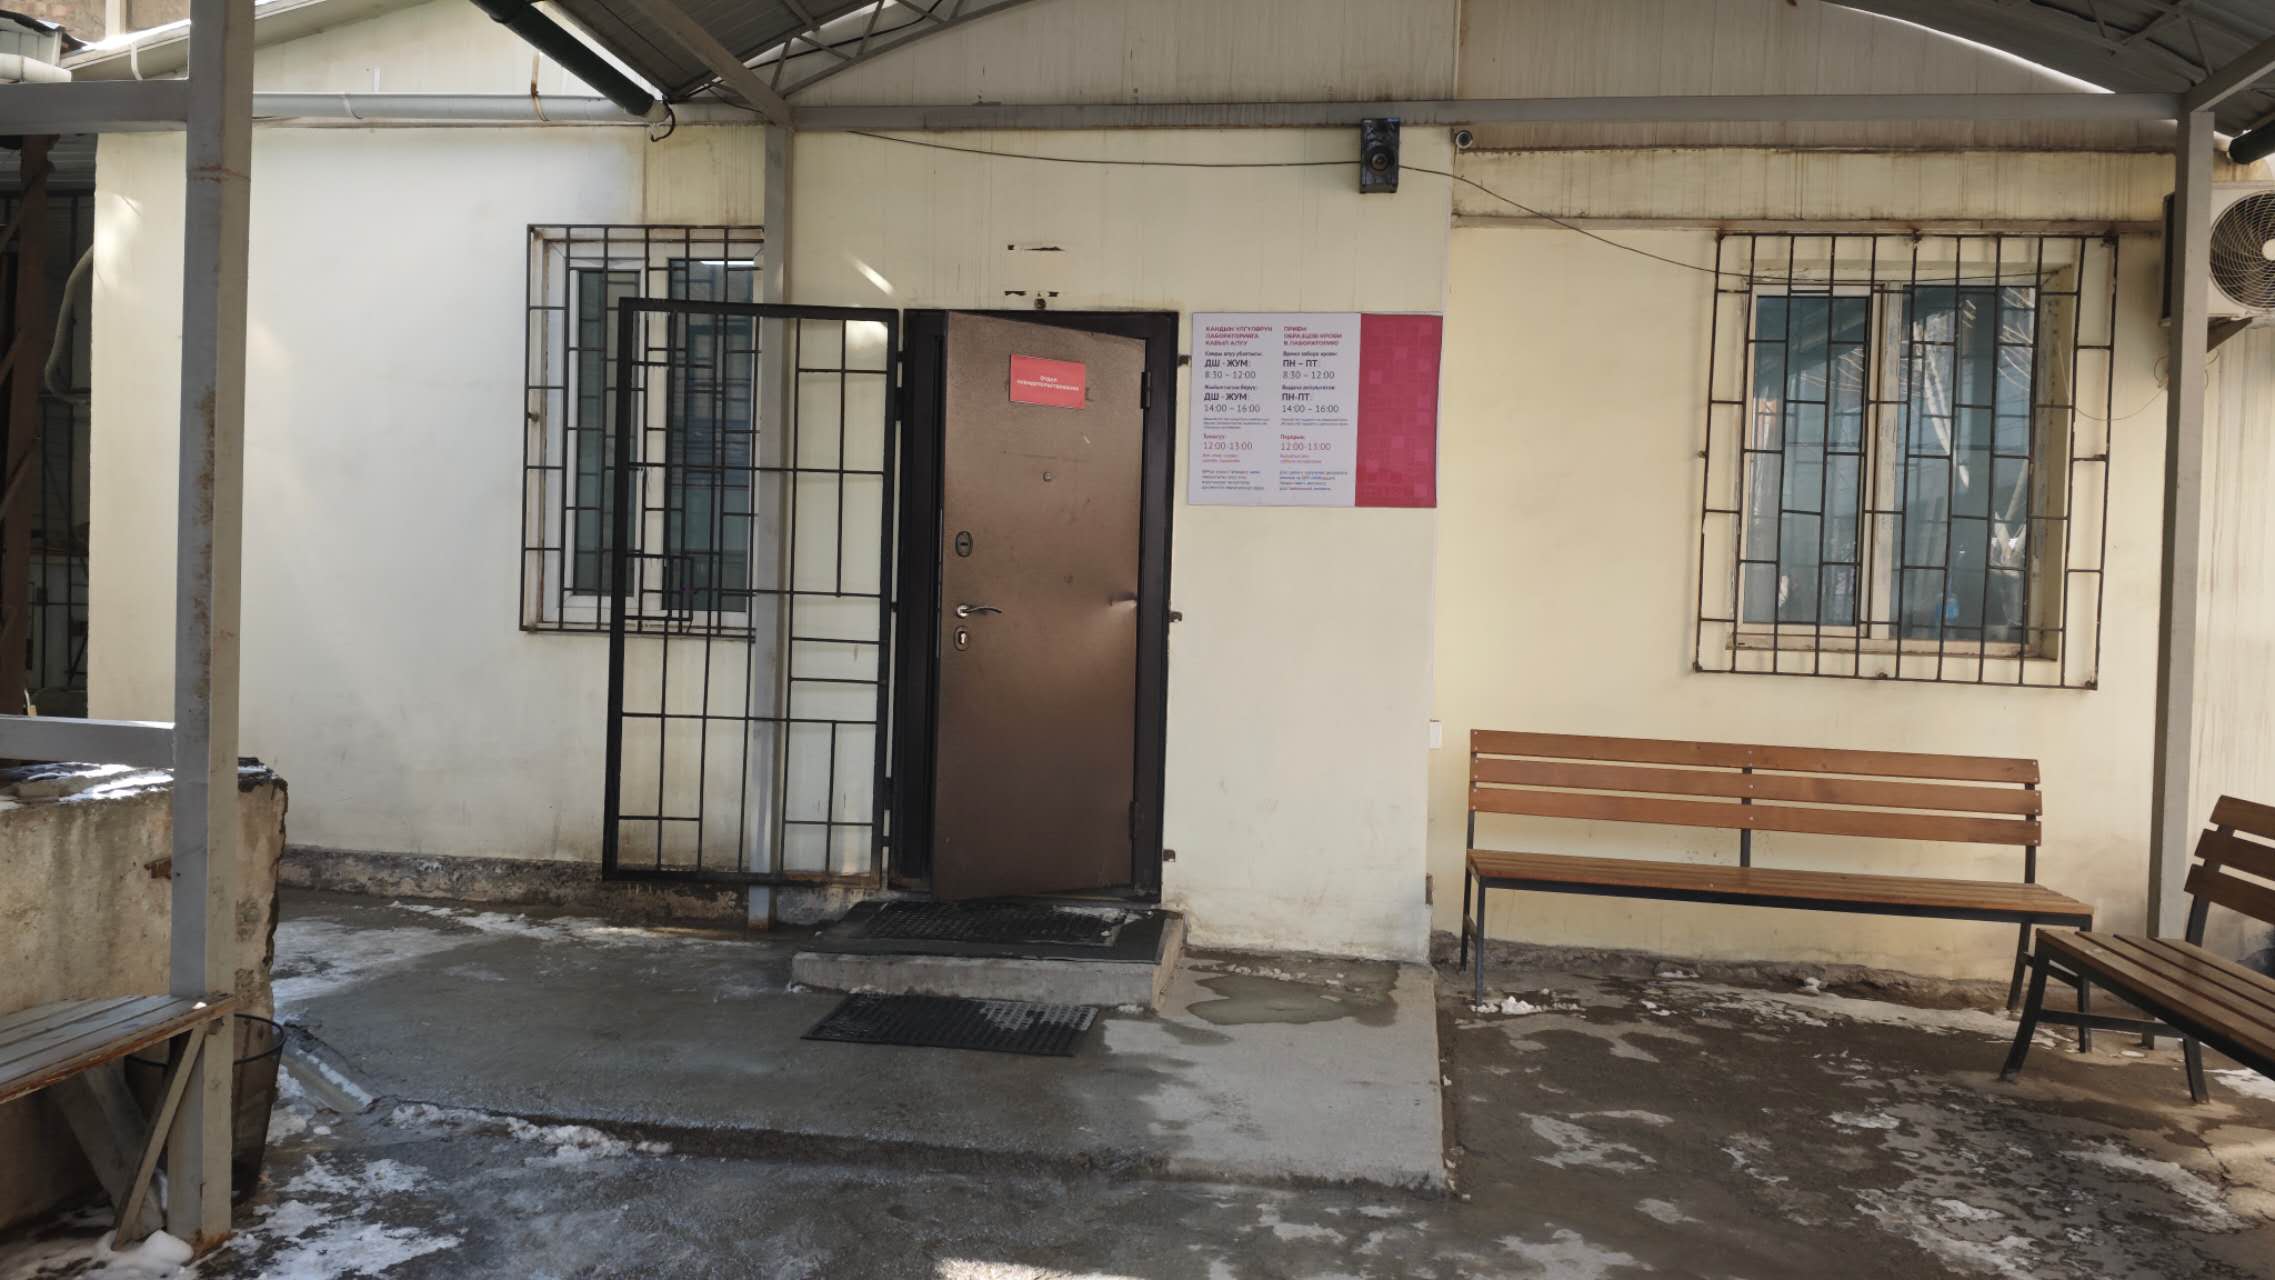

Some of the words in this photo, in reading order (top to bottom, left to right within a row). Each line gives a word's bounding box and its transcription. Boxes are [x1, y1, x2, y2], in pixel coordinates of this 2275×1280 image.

[1204, 359, 1220, 368] ДШ
[1282, 359, 1296, 367] ПН
[1204, 370, 1223, 379] 8:30
[1232, 370, 1257, 379] 12:00
[1282, 370, 1301, 379] 8:30
[1311, 370, 1336, 380] 12:00
[1203, 392, 1220, 402] ДШ
[1203, 404, 1228, 413] 14:00
[1237, 404, 1261, 413] 16:00
[1281, 404, 1306, 413] 14:00
[1315, 404, 1340, 413] 16:00
